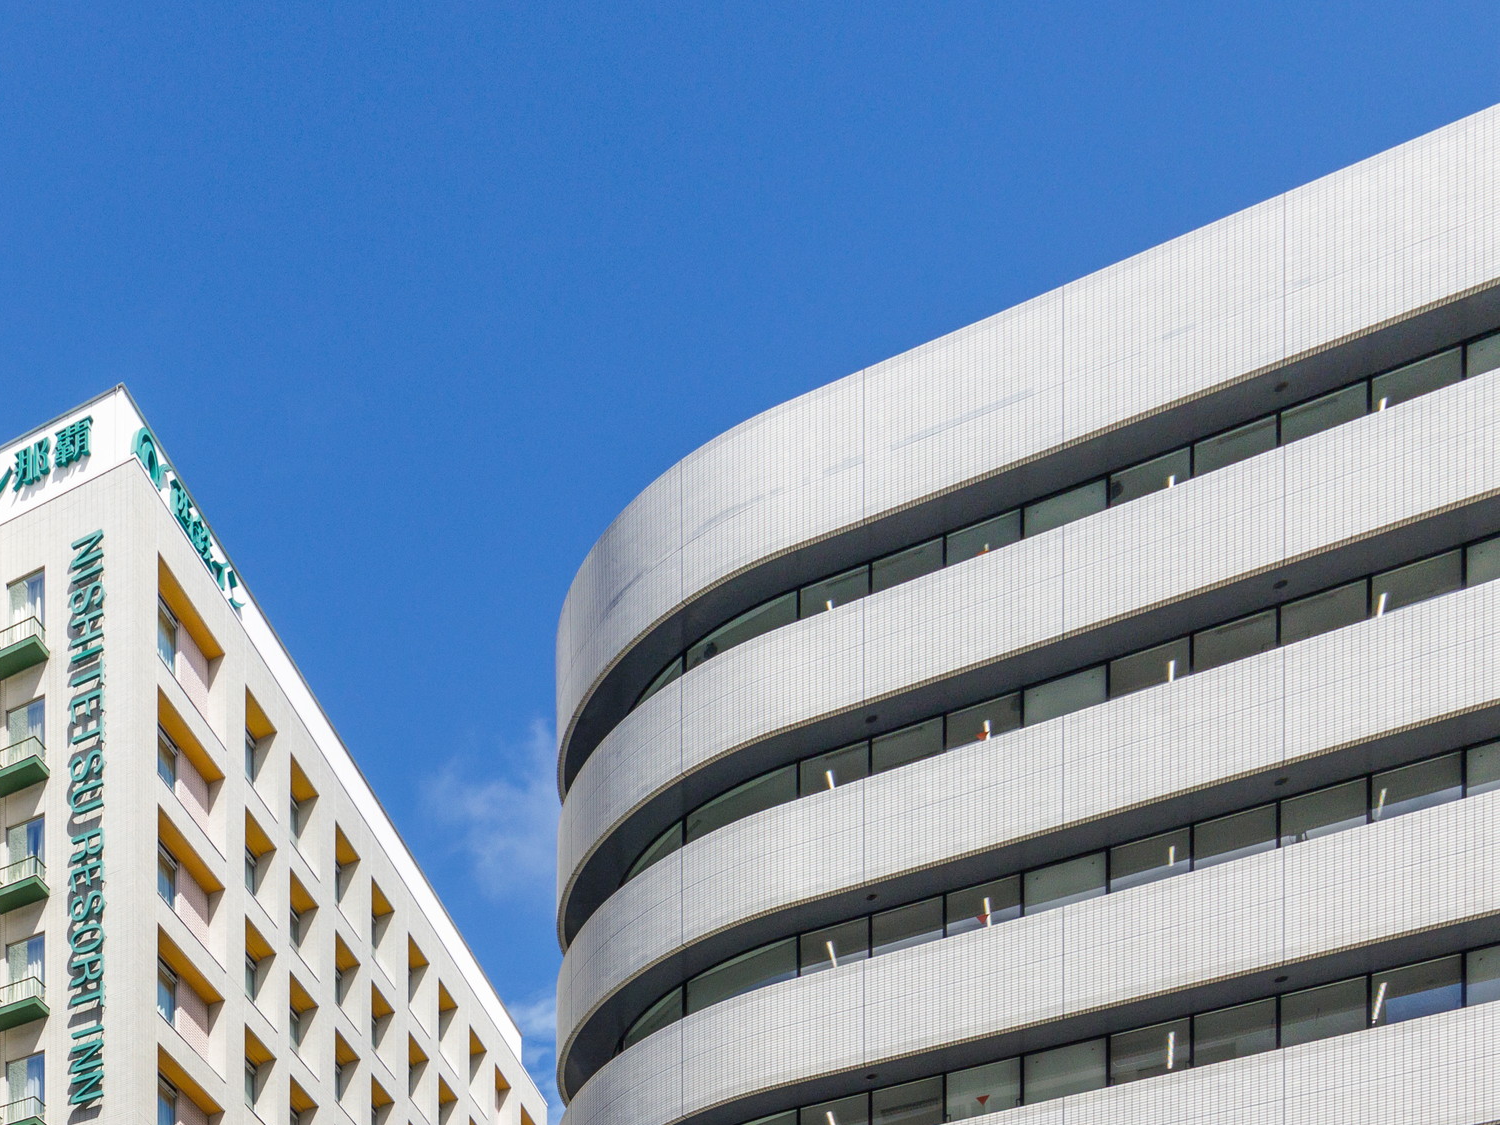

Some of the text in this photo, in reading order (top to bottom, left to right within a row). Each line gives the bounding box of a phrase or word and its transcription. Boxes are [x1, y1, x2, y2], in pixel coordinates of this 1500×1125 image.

[70, 528, 105, 1105] NISHITETSU RESORT INN
